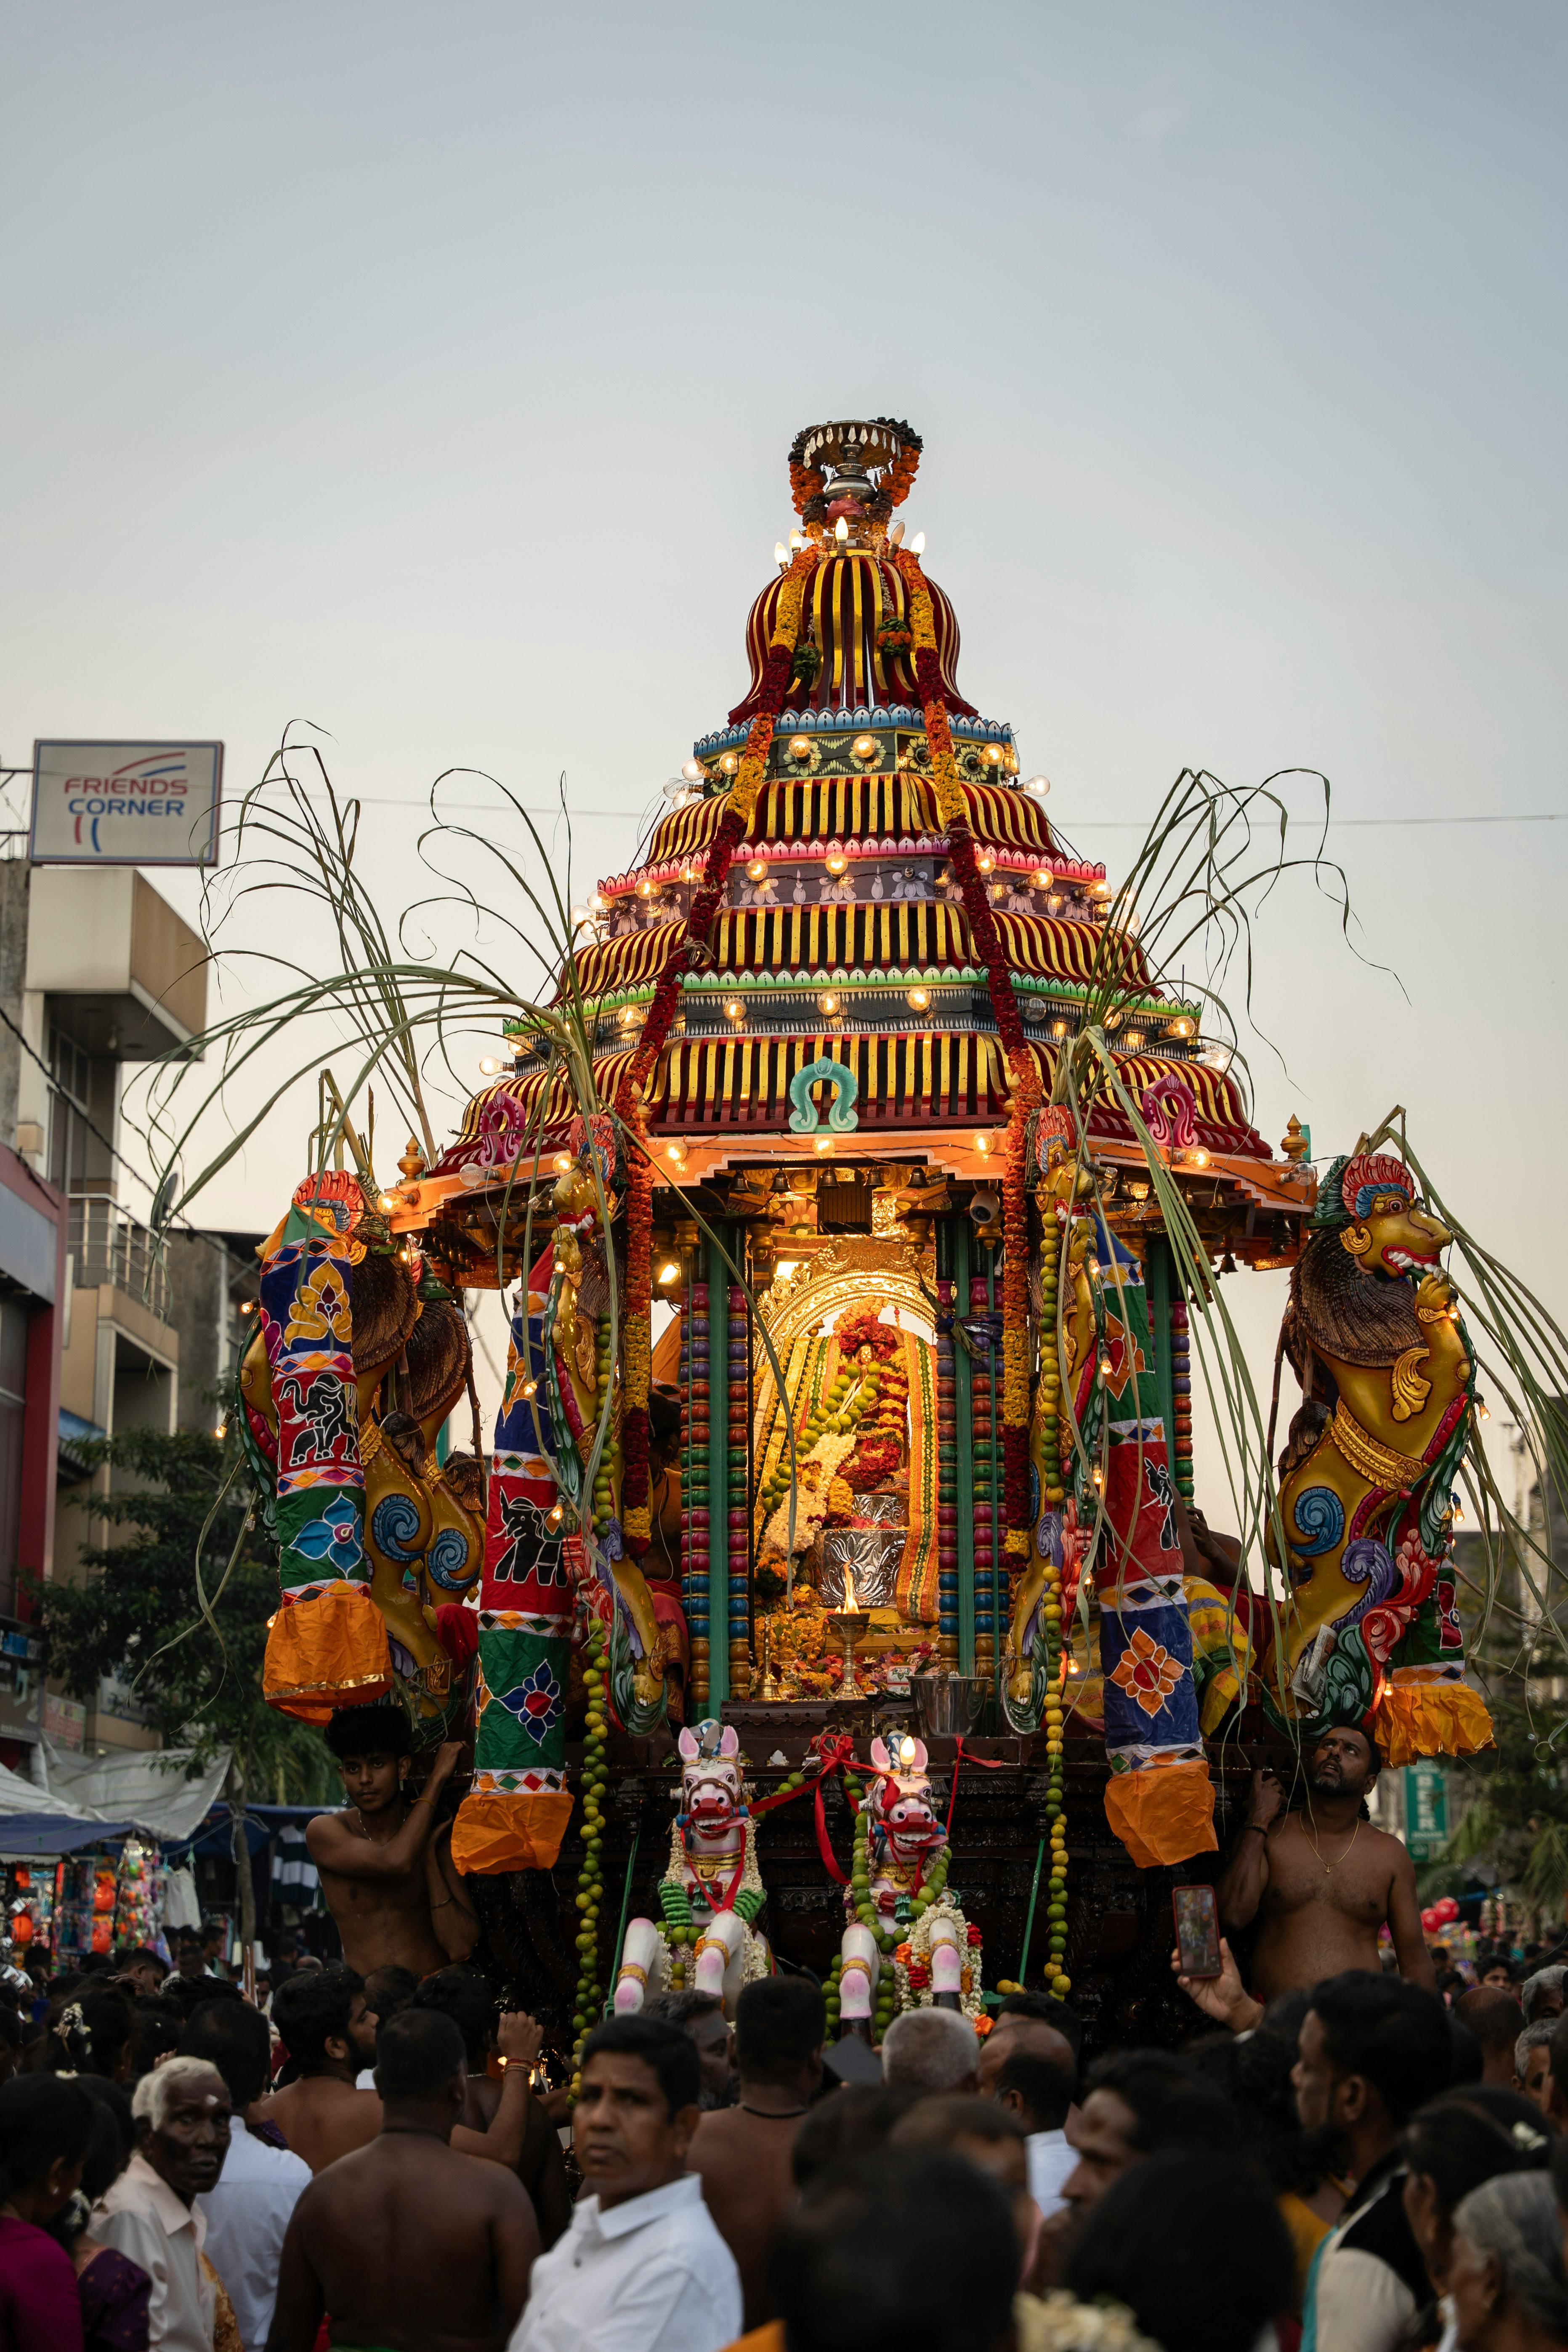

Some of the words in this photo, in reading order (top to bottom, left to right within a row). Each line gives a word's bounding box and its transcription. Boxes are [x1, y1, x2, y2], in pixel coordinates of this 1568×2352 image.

[64, 778, 188, 795] FRIENDS
[69, 799, 184, 817] CORNER
[1417, 1775, 1435, 1831] BEER
